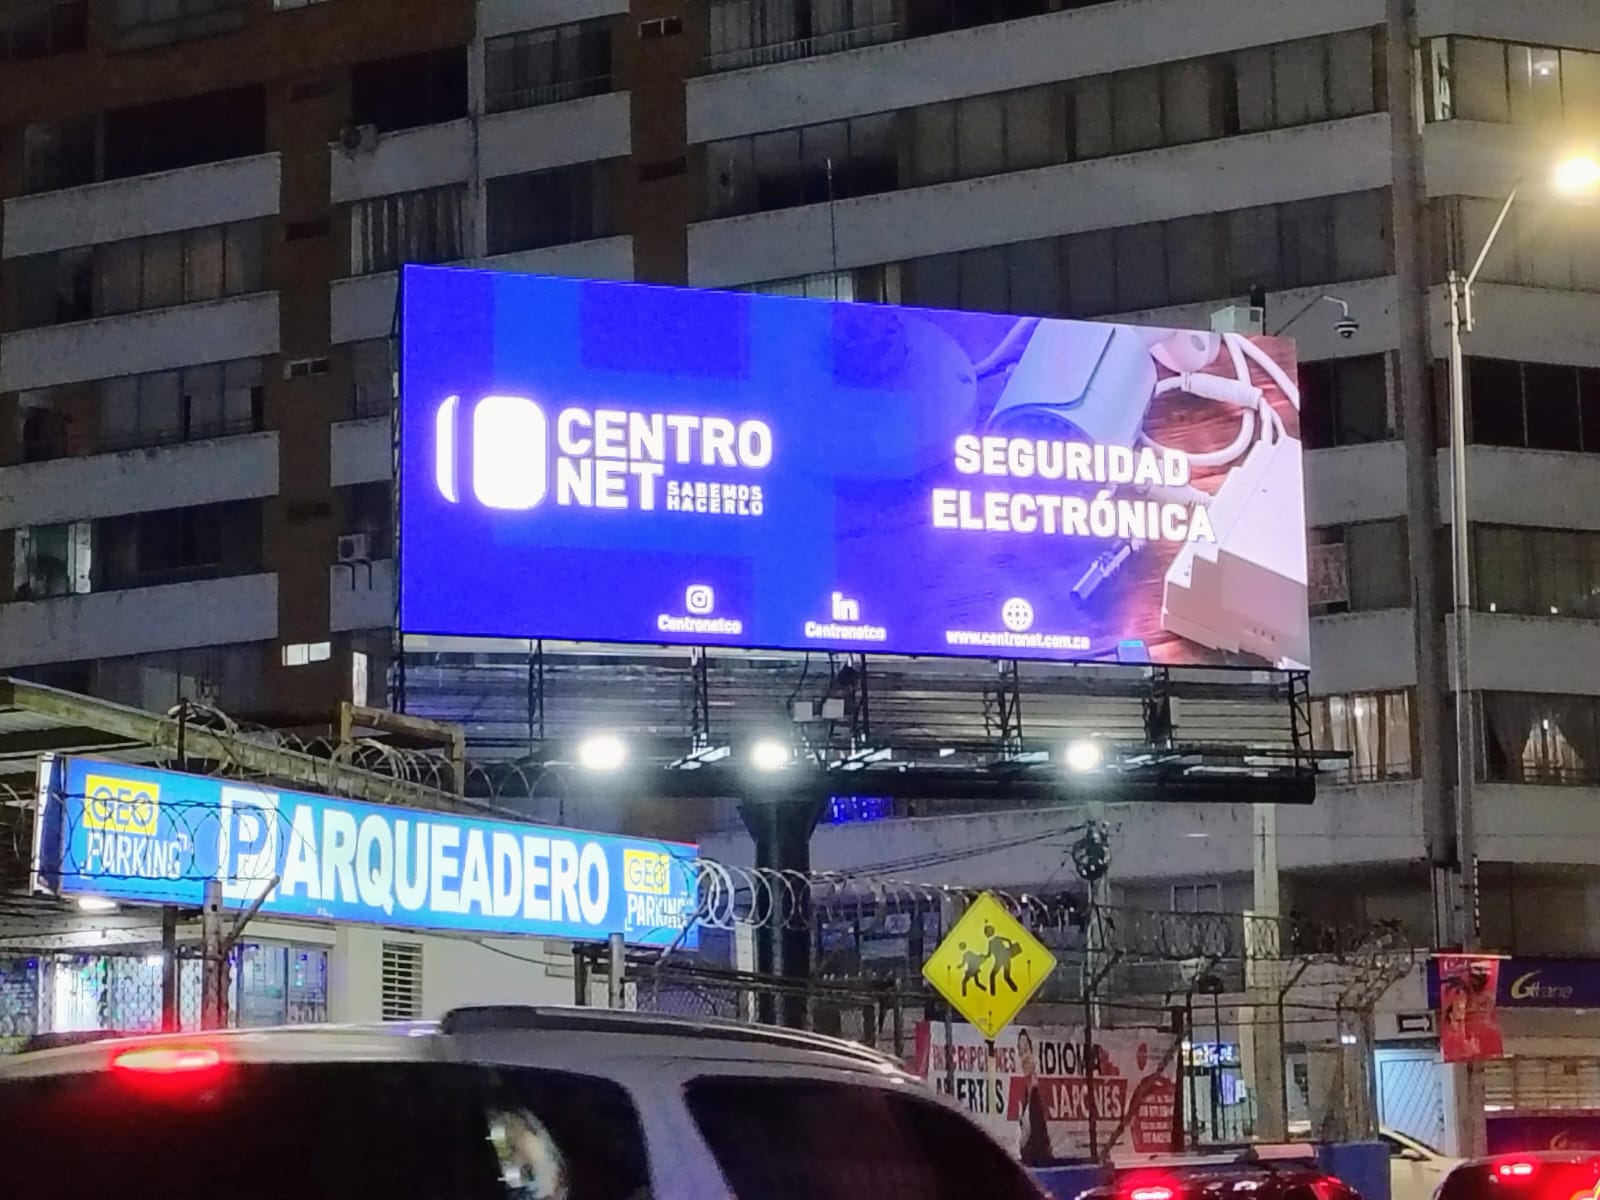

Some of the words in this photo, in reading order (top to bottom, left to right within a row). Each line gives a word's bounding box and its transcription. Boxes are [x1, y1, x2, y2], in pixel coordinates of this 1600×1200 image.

[557, 407, 773, 468] CENTRO
[954, 434, 1190, 487] SEGURIDAD
[556, 457, 664, 510] NET
[667, 481, 763, 500] SABEMOS
[667, 498, 763, 516] HACERLO
[931, 487, 1216, 543] ELECTRÓNICA
[91, 786, 154, 828] GEO
[87, 832, 181, 878] PARKING
[220, 786, 609, 925] PARQUEADERO
[629, 858, 667, 888] GEO
[627, 893, 686, 929] PARKING
[931, 1044, 1016, 1073] INCRIPCINES
[1038, 1041, 1102, 1075] IDIOMA
